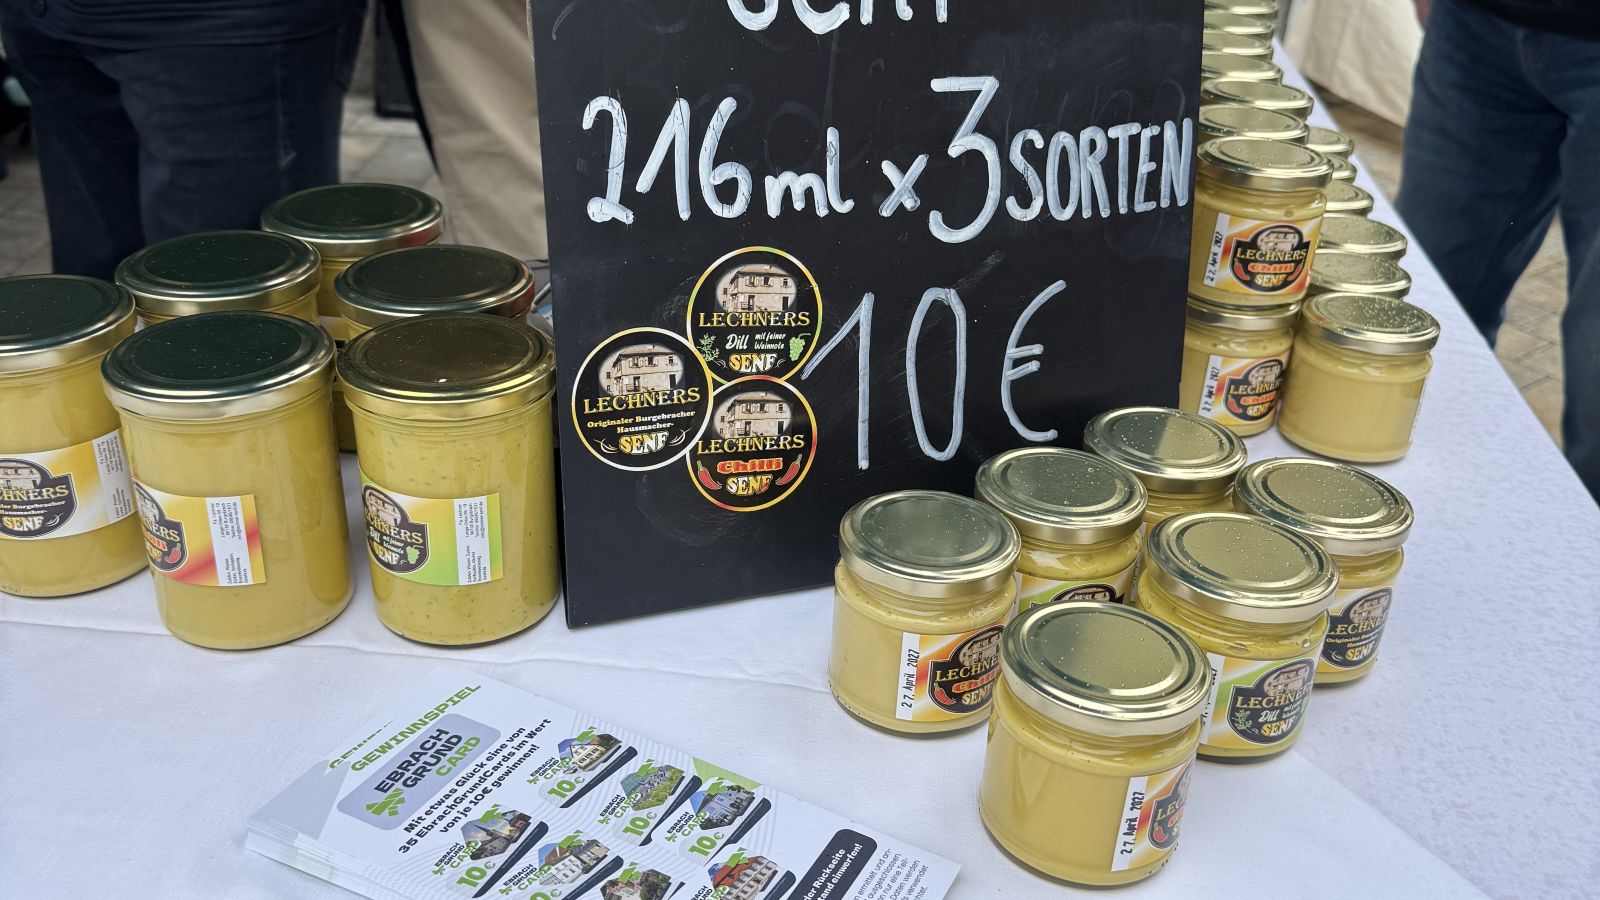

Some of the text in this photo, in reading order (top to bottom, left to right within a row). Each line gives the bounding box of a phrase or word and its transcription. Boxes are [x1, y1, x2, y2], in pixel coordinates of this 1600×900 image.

[582, 75, 1193, 243] 216 ml x 3 SORTEN
[1236, 247, 1307, 261] LECHNERS
[1254, 273, 1287, 287] SENF
[699, 311, 811, 327] LECHNERS
[725, 333, 750, 350] Dill
[754, 331, 786, 341] mit feiner
[728, 353, 777, 374] SENF
[801, 279, 1067, 470] 10€
[583, 387, 700, 415] LECHNERS
[587, 410, 696, 428] Originaler Burgebracher
[616, 422, 675, 434] Hausmacher-
[619, 430, 669, 455] SENF
[697, 434, 805, 455] LECHNERS
[717, 458, 783, 474] Chilli
[726, 474, 773, 496] SENF
[2, 516, 45, 532] SENF
[907, 648, 920, 668] 2027
[935, 655, 999, 681] LECHNE
[902, 673, 915, 692] April
[350, 684, 481, 771] GEWINNSPIEL
[1257, 709, 1280, 723] Dill
[374, 728, 450, 794] EBRACH
[402, 734, 463, 788] GRUND
[435, 736, 481, 777] CARD
[530, 756, 556, 777] EBRACH
[399, 718, 552, 854] 35 EbrachGrundCards im Wert
[403, 727, 526, 834] Mit etwas Glück eine von
[439, 744, 541, 834] von je 10€ gewinnen!
[547, 776, 585, 799] 10€
[600, 794, 621, 817] EBRACH
[1129, 791, 1145, 812] 2027
[622, 811, 658, 837] 10€
[667, 811, 690, 834] EBRACH
[1122, 816, 1138, 836] April
[435, 842, 460, 867] EBRACH
[688, 831, 725, 857] 10€
[456, 860, 495, 888] 10€
[503, 863, 534, 886] EBRACH
[813, 848, 846, 889] Rückseite
[831, 843, 863, 884] einwerfen!
